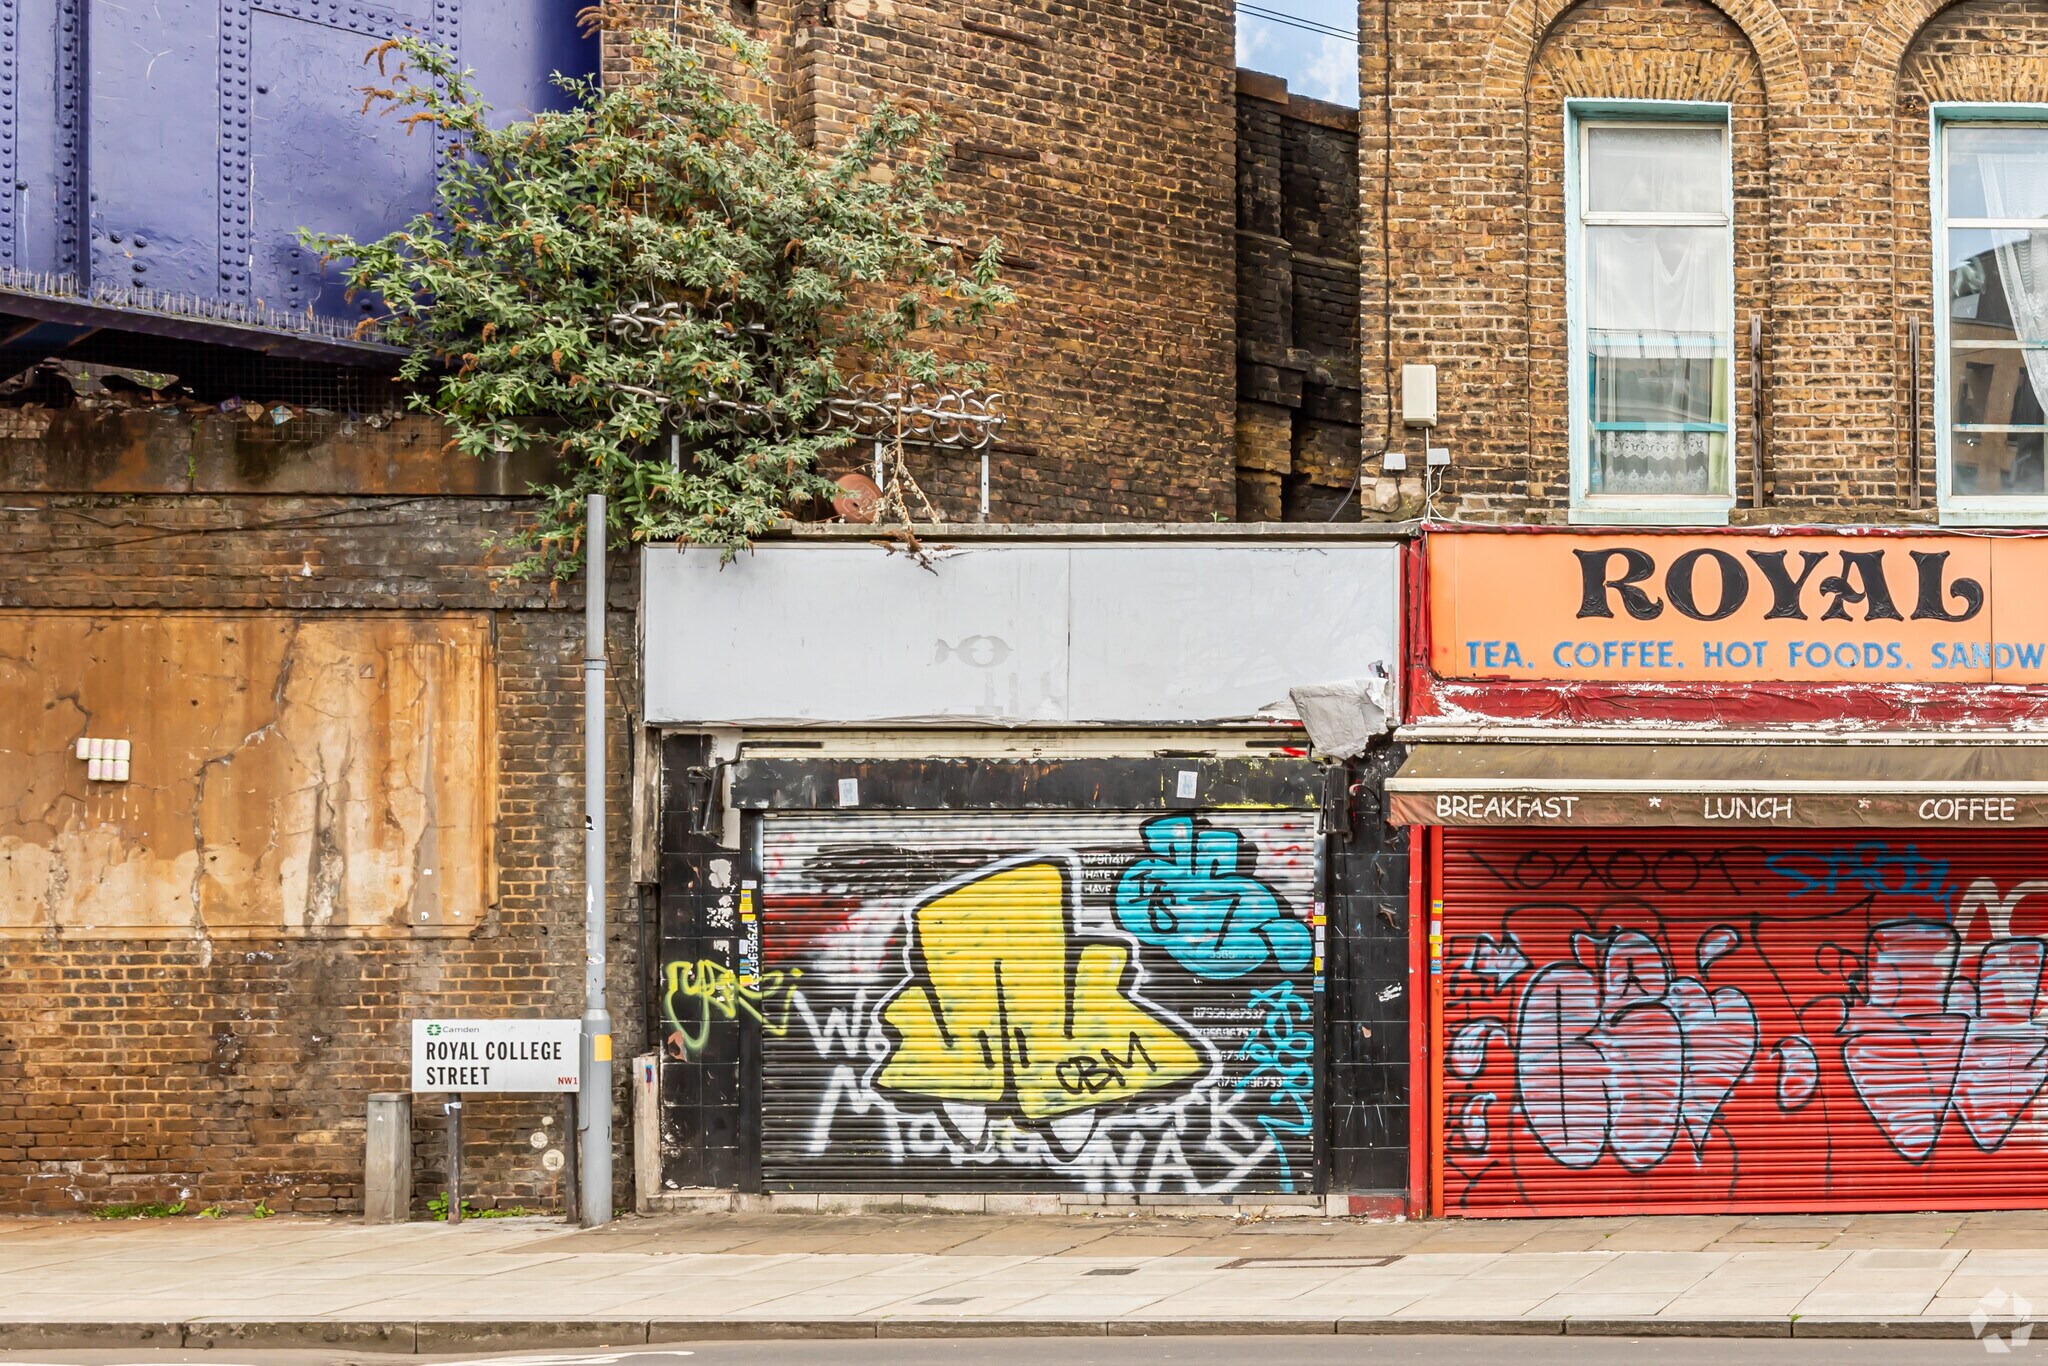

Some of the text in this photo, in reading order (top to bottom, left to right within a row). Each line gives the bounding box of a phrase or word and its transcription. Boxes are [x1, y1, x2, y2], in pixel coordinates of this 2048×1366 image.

[1573, 548, 1983, 622] ROYAL
[1466, 640, 2045, 670] TEA. COFFEE. HOT FOODS. SANDW
[1436, 795, 2016, 821] BREAKFAST LUNCH COFFEE
[426, 1041, 562, 1061] ROYAL COLLEGE
[426, 1066, 578, 1086] STREET NW1
